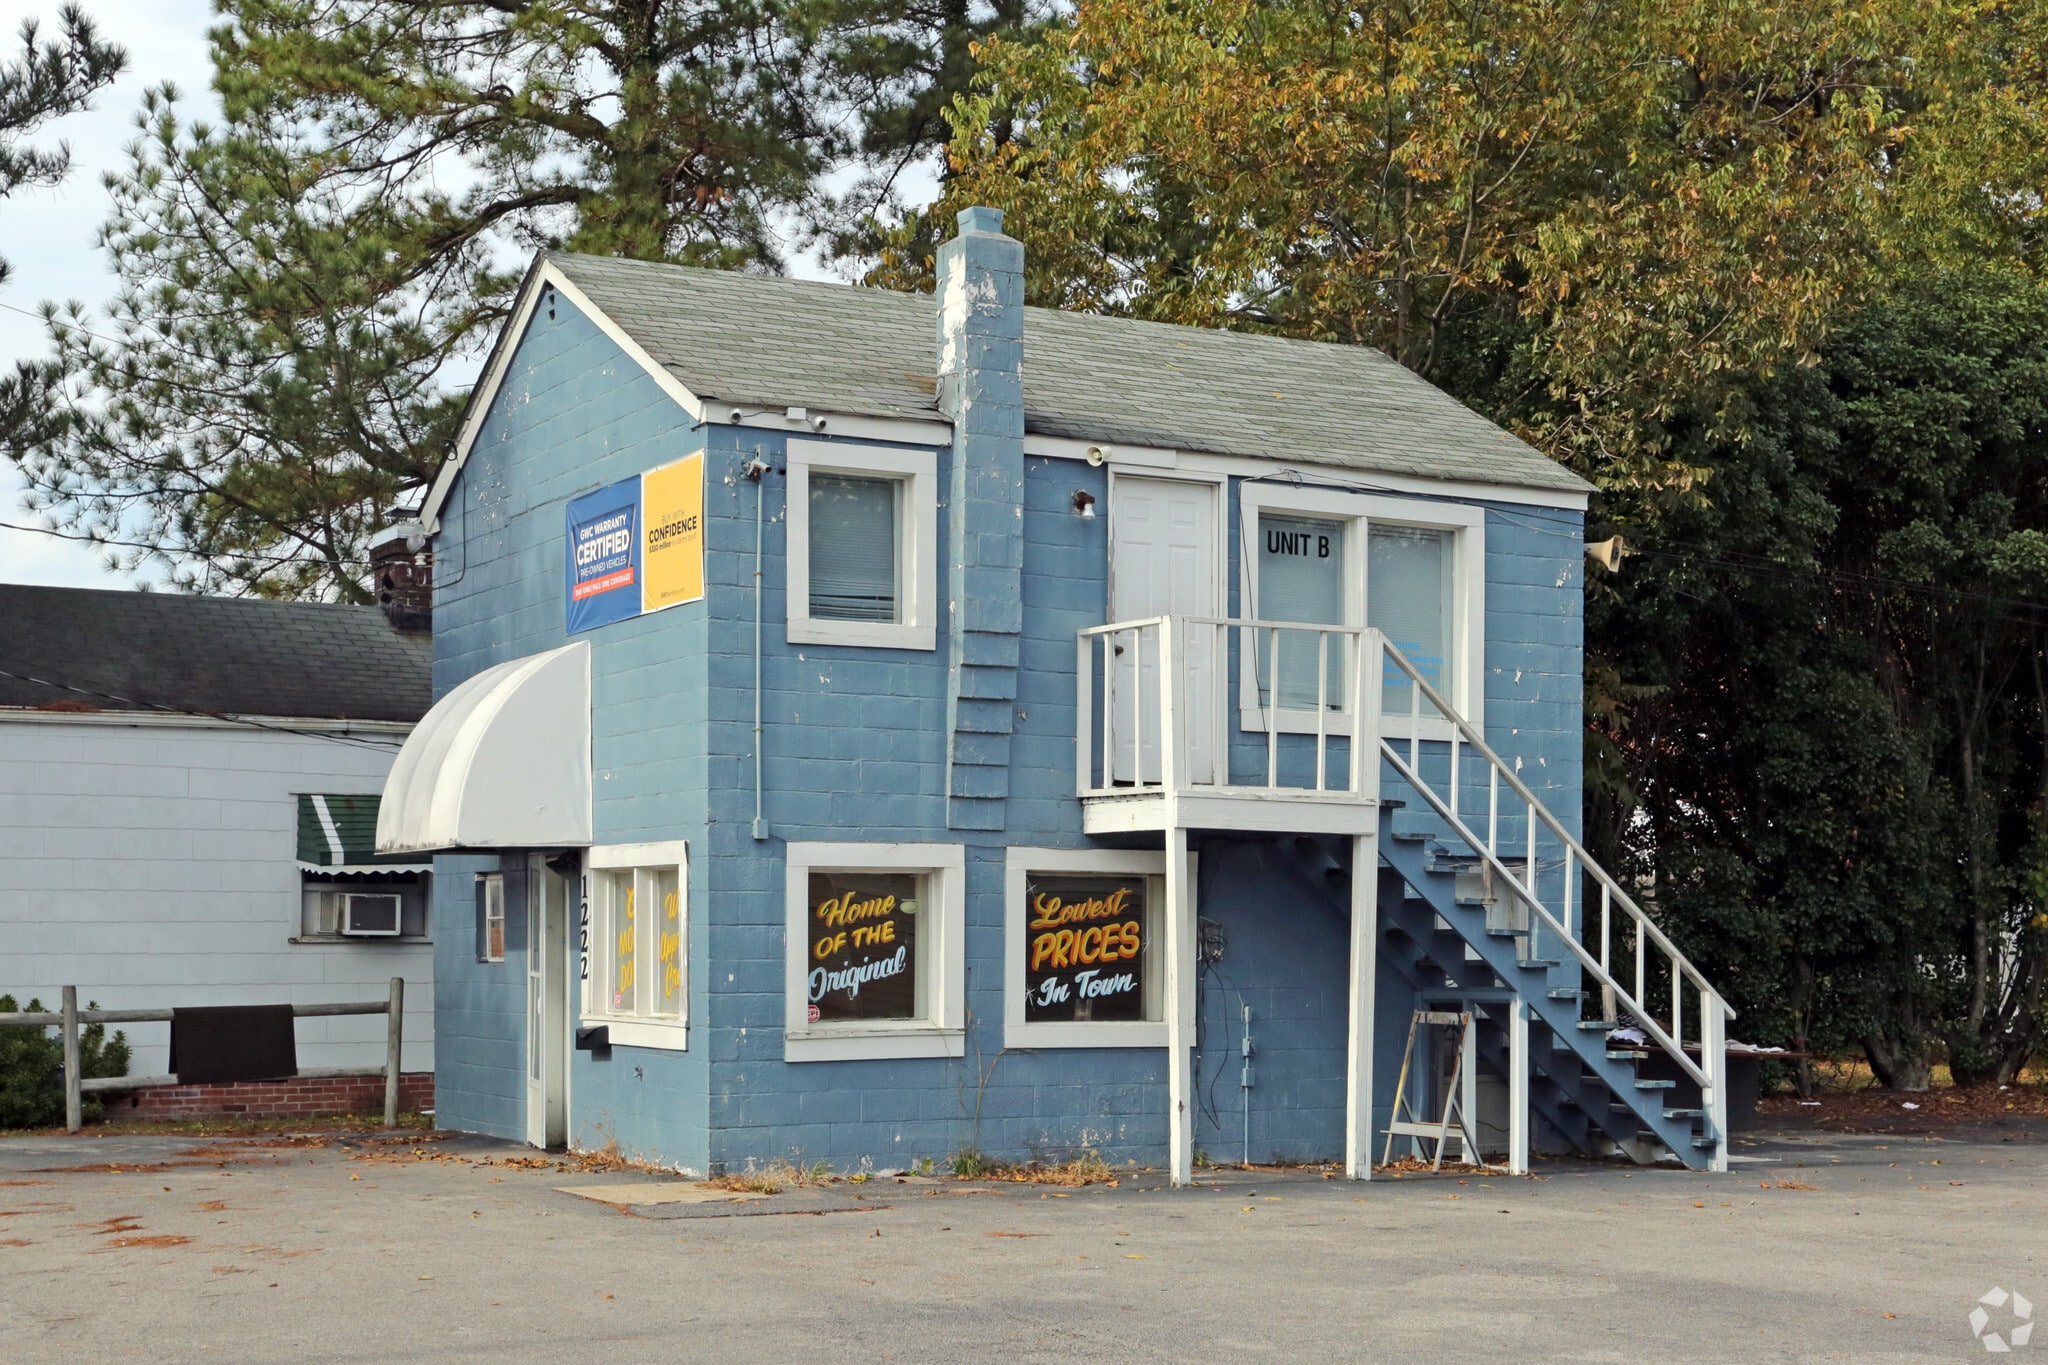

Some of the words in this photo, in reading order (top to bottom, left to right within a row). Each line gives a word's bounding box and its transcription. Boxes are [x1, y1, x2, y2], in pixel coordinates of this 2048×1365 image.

[580, 526, 594, 541] GWC
[594, 514, 627, 536] WARRANTY
[648, 516, 697, 544] CONFIDENCE
[1268, 530, 1312, 556] UNIT
[1318, 535, 1330, 558] B
[577, 529, 630, 566] CERTIFIED
[580, 562, 606, 577] PRE-OWNED
[606, 554, 627, 569] VEHICLES
[580, 874, 588, 980] 1222
[816, 890, 895, 928] Home
[1030, 887, 1133, 929] Lowest
[814, 932, 847, 960] OF
[852, 920, 896, 948] THE
[1031, 921, 1140, 972] PRICES
[808, 945, 906, 1003] Original
[1037, 977, 1070, 1007] In
[1074, 968, 1138, 999] Town
